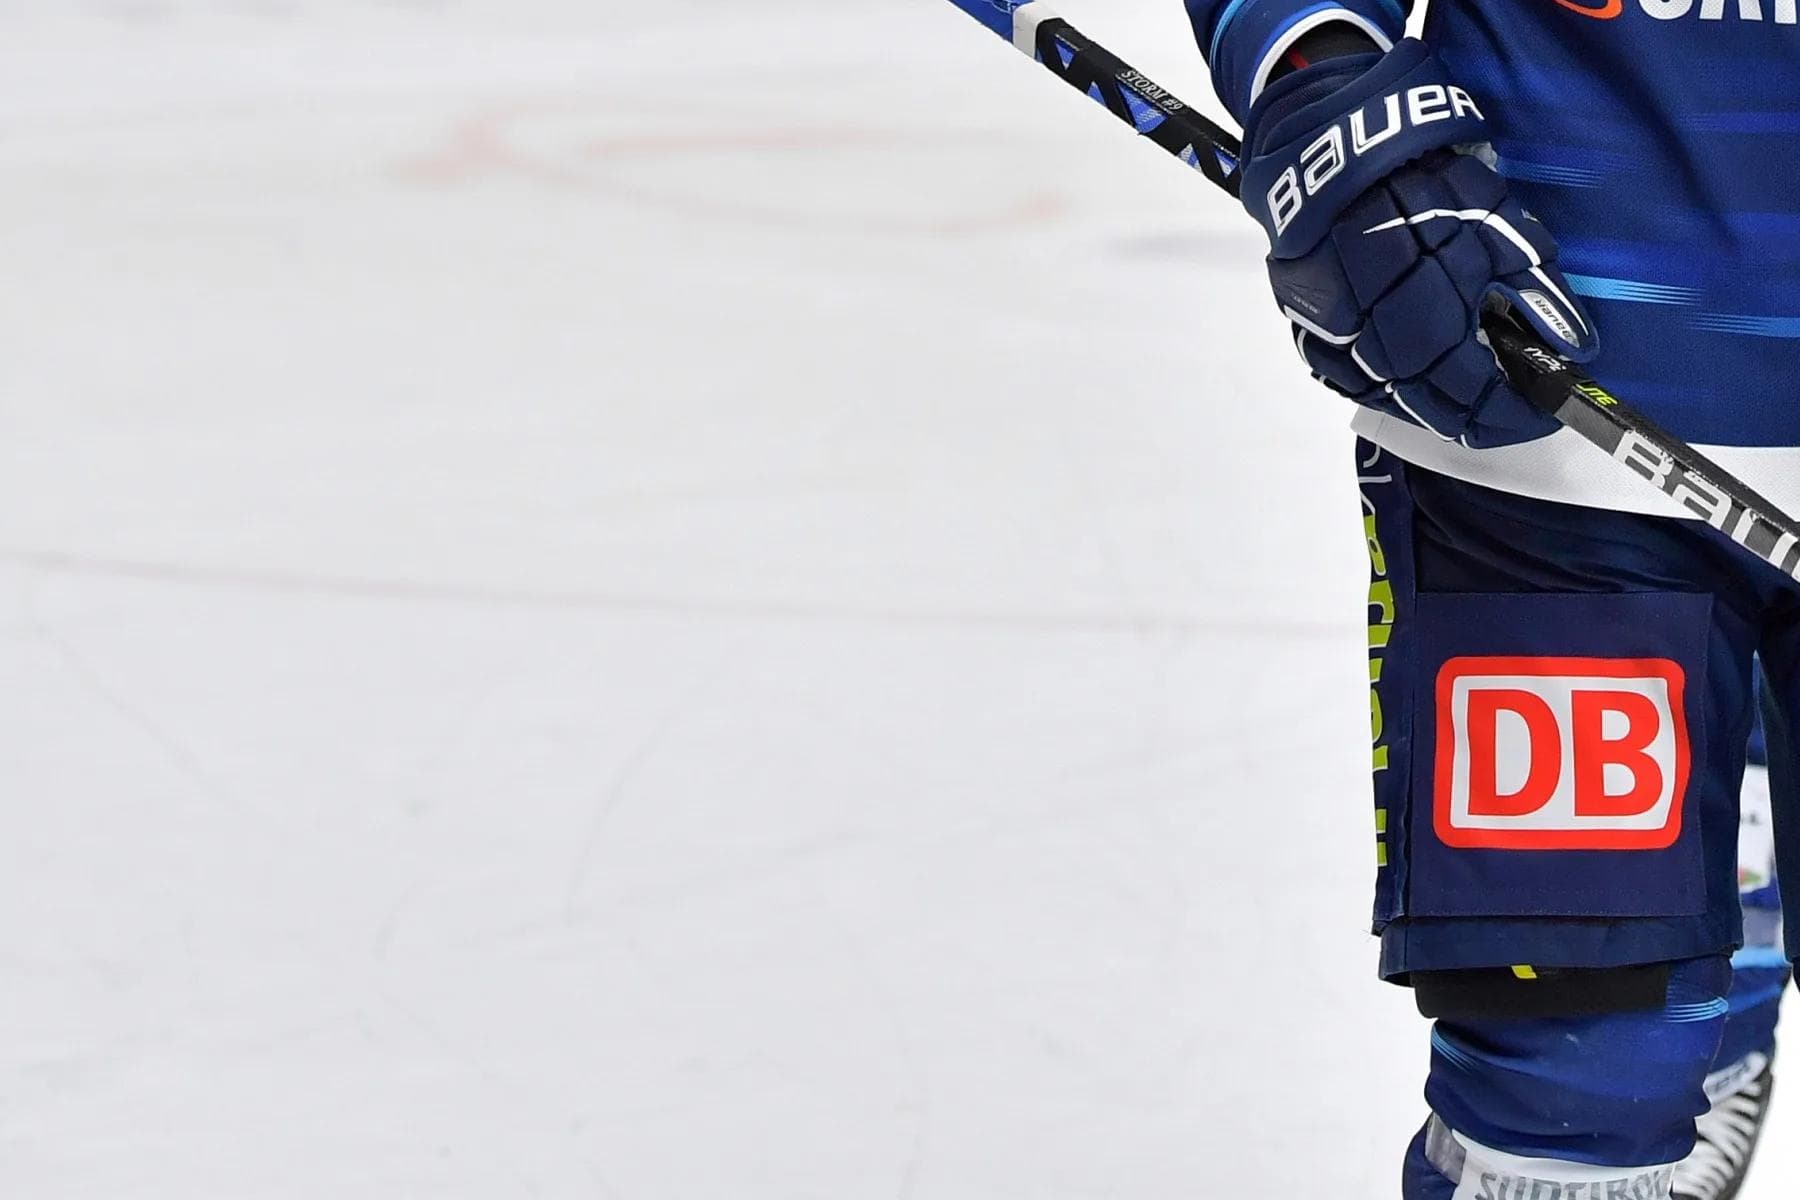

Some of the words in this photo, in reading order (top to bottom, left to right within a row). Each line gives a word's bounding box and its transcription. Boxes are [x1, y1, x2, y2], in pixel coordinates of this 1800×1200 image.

[1120, 70, 1168, 100] STORM
[1161, 98, 1184, 110] #9
[1467, 688, 1664, 818] DB
